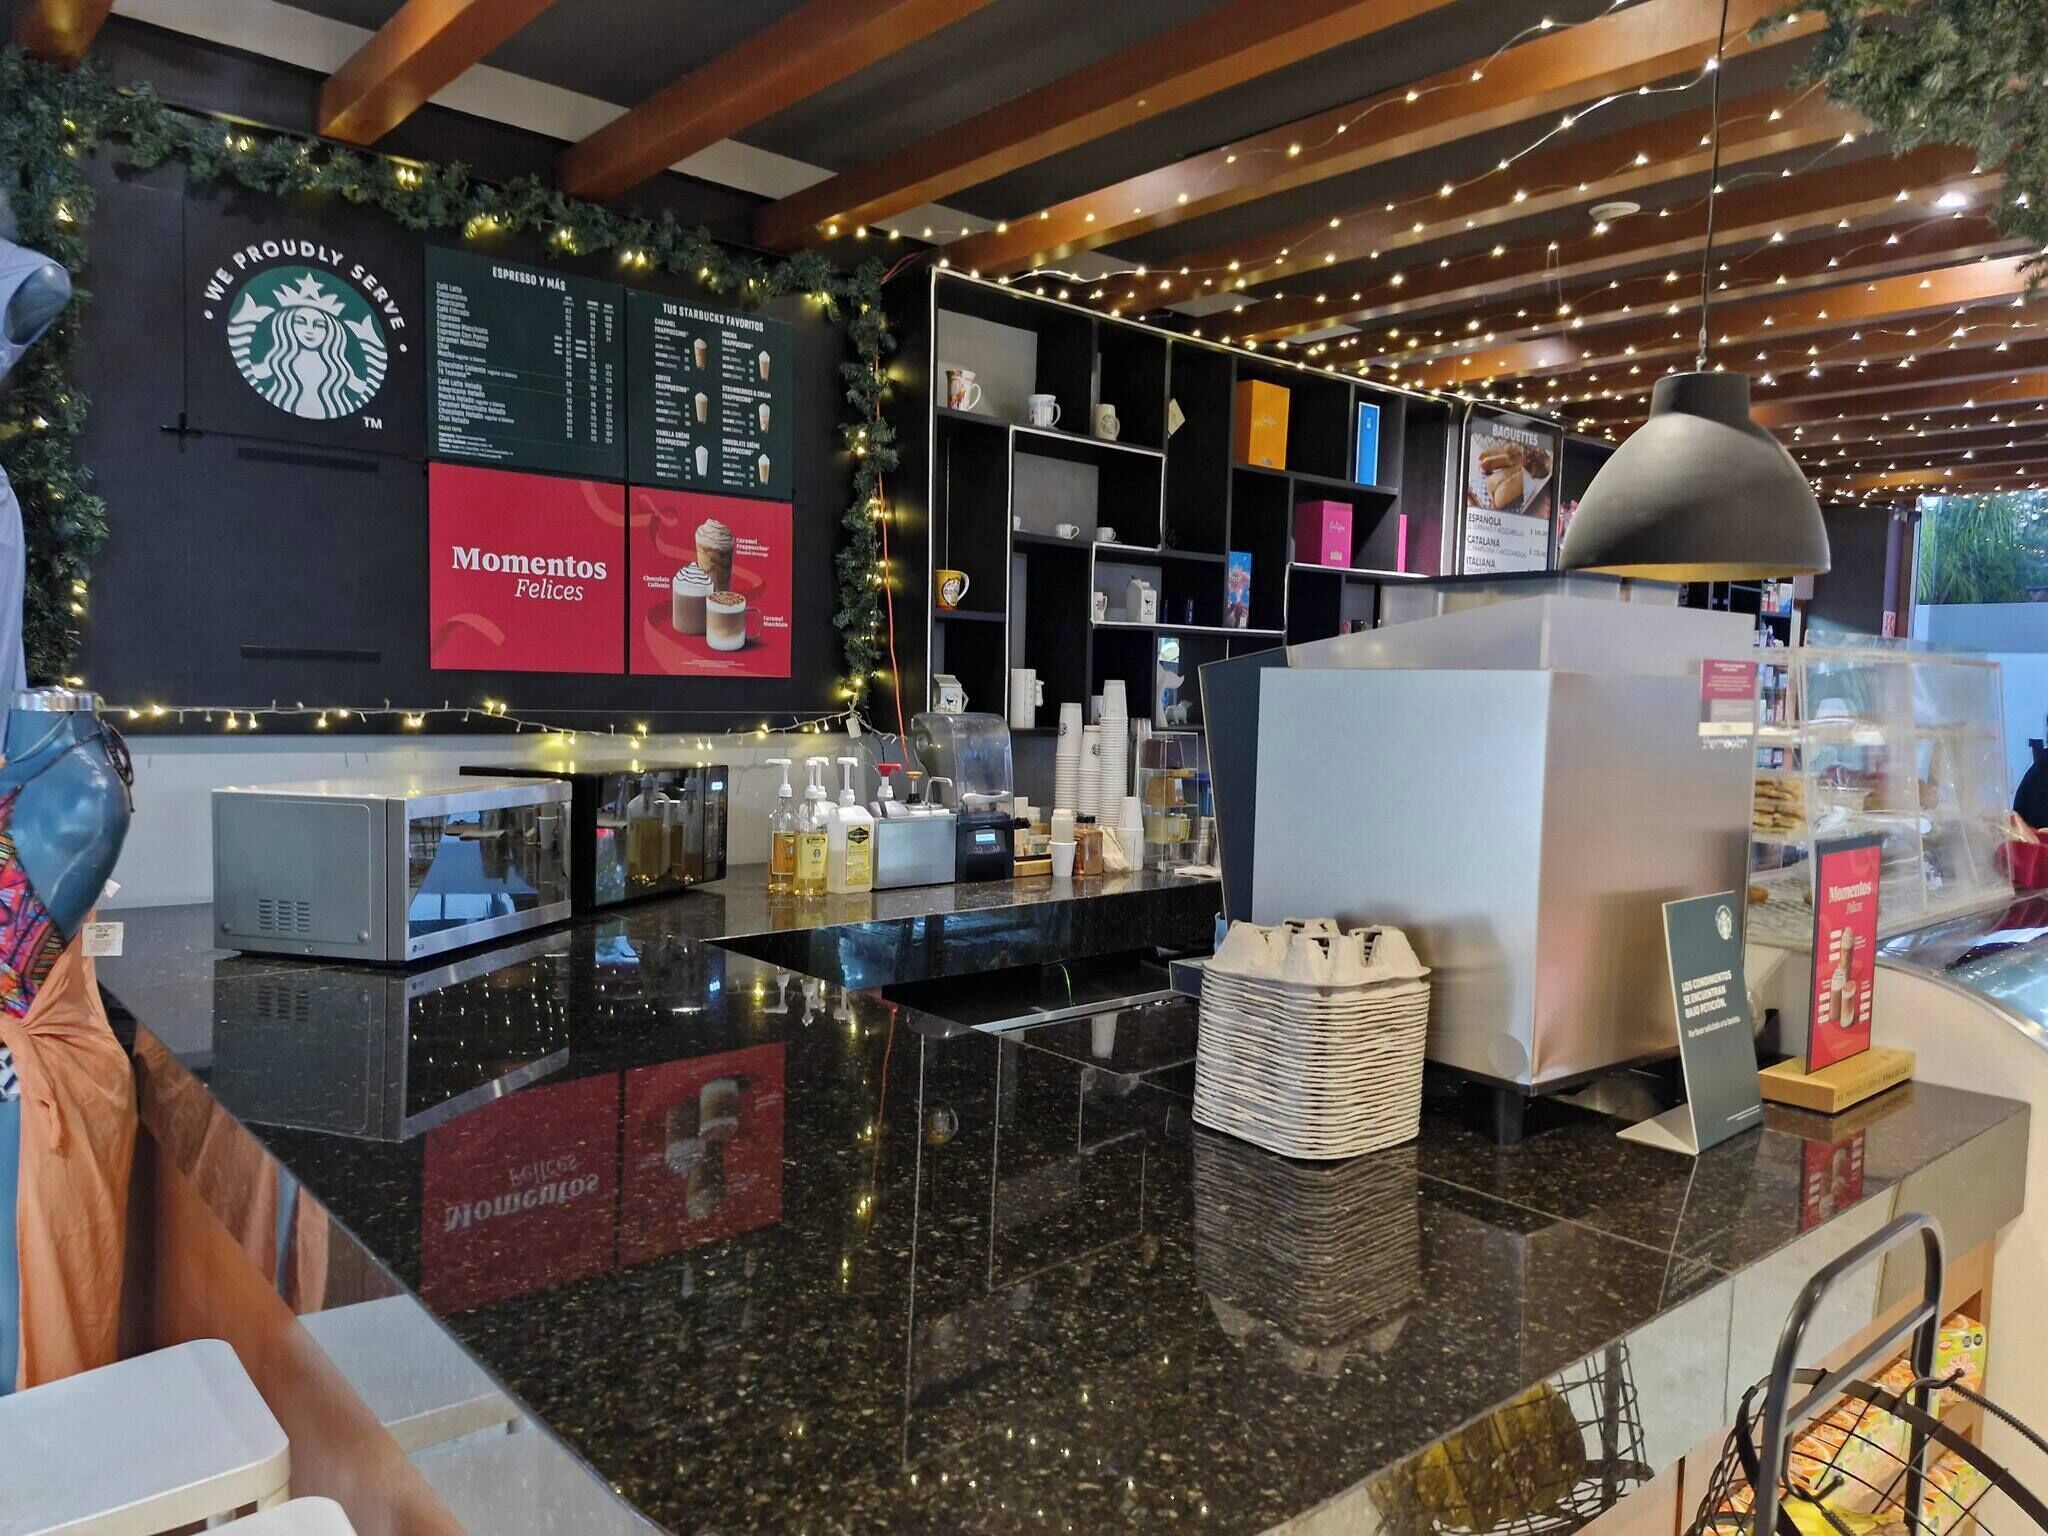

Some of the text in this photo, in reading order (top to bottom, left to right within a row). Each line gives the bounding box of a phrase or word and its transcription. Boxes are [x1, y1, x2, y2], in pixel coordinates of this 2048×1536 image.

[204, 239, 405, 330] WE PROUDLY SERVE
[492, 266, 566, 291] ESPRESSO Y MÁS
[662, 303, 677, 315] TUS
[726, 316, 764, 332] FAVORITOS
[1492, 424, 1538, 446] BAGUETTES
[736, 537, 757, 545] Caramel
[1468, 535, 1500, 547] CATALANA
[452, 546, 607, 580] Momentos
[1466, 556, 1495, 568] ITALIANA
[515, 578, 584, 601] Felices
[1828, 881, 1872, 903] Momentos
[1681, 980, 1692, 992] LOS
